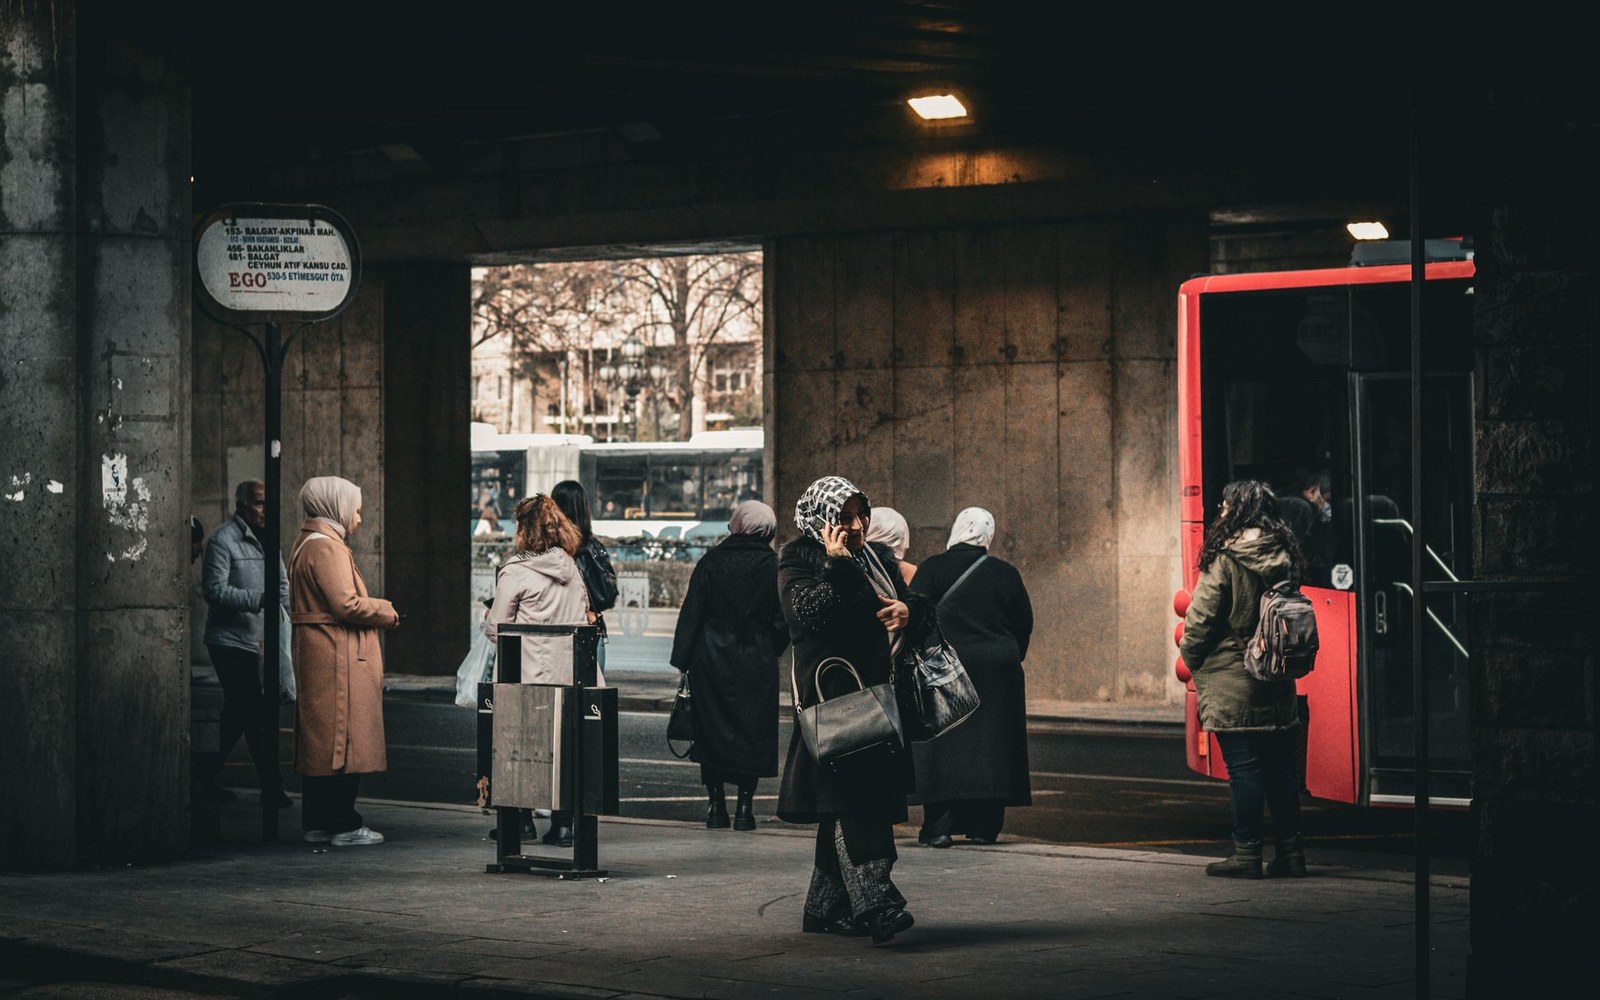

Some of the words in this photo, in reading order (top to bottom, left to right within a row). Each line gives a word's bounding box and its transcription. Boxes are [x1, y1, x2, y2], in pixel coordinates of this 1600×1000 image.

[245, 227, 316, 236] BALGAT-AKPINAR
[317, 228, 336, 236] MAH.
[246, 245, 305, 253] BAKANLIKLAR
[248, 253, 280, 261] BALGAT
[247, 261, 282, 269] CEYHUN
[284, 261, 301, 269] ATIF
[303, 262, 329, 270] KANSU
[331, 262, 348, 270] CAD.
[228, 272, 267, 288] EGO
[267, 272, 287, 280] 530-5
[288, 271, 330, 281] ETİMESGUT
